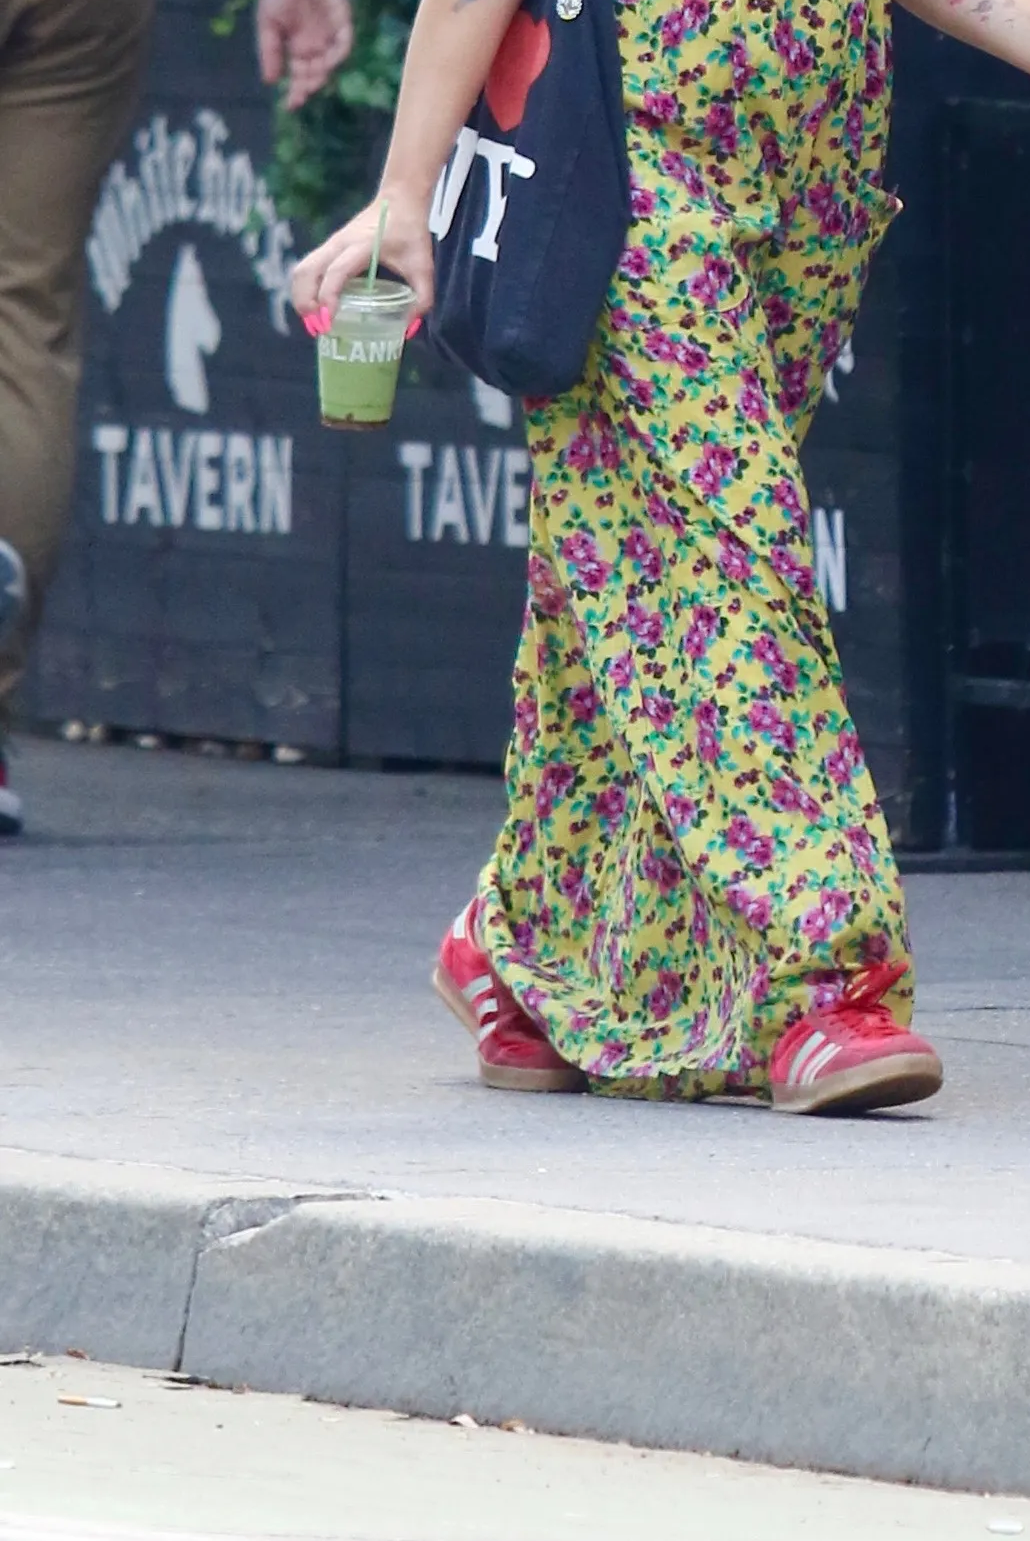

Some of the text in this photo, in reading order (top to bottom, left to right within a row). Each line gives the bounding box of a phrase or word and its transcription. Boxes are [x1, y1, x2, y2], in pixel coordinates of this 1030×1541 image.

[319, 334, 403, 363] BLANK
[93, 425, 293, 535] TAVERN
[399, 443, 530, 547] TAVE
